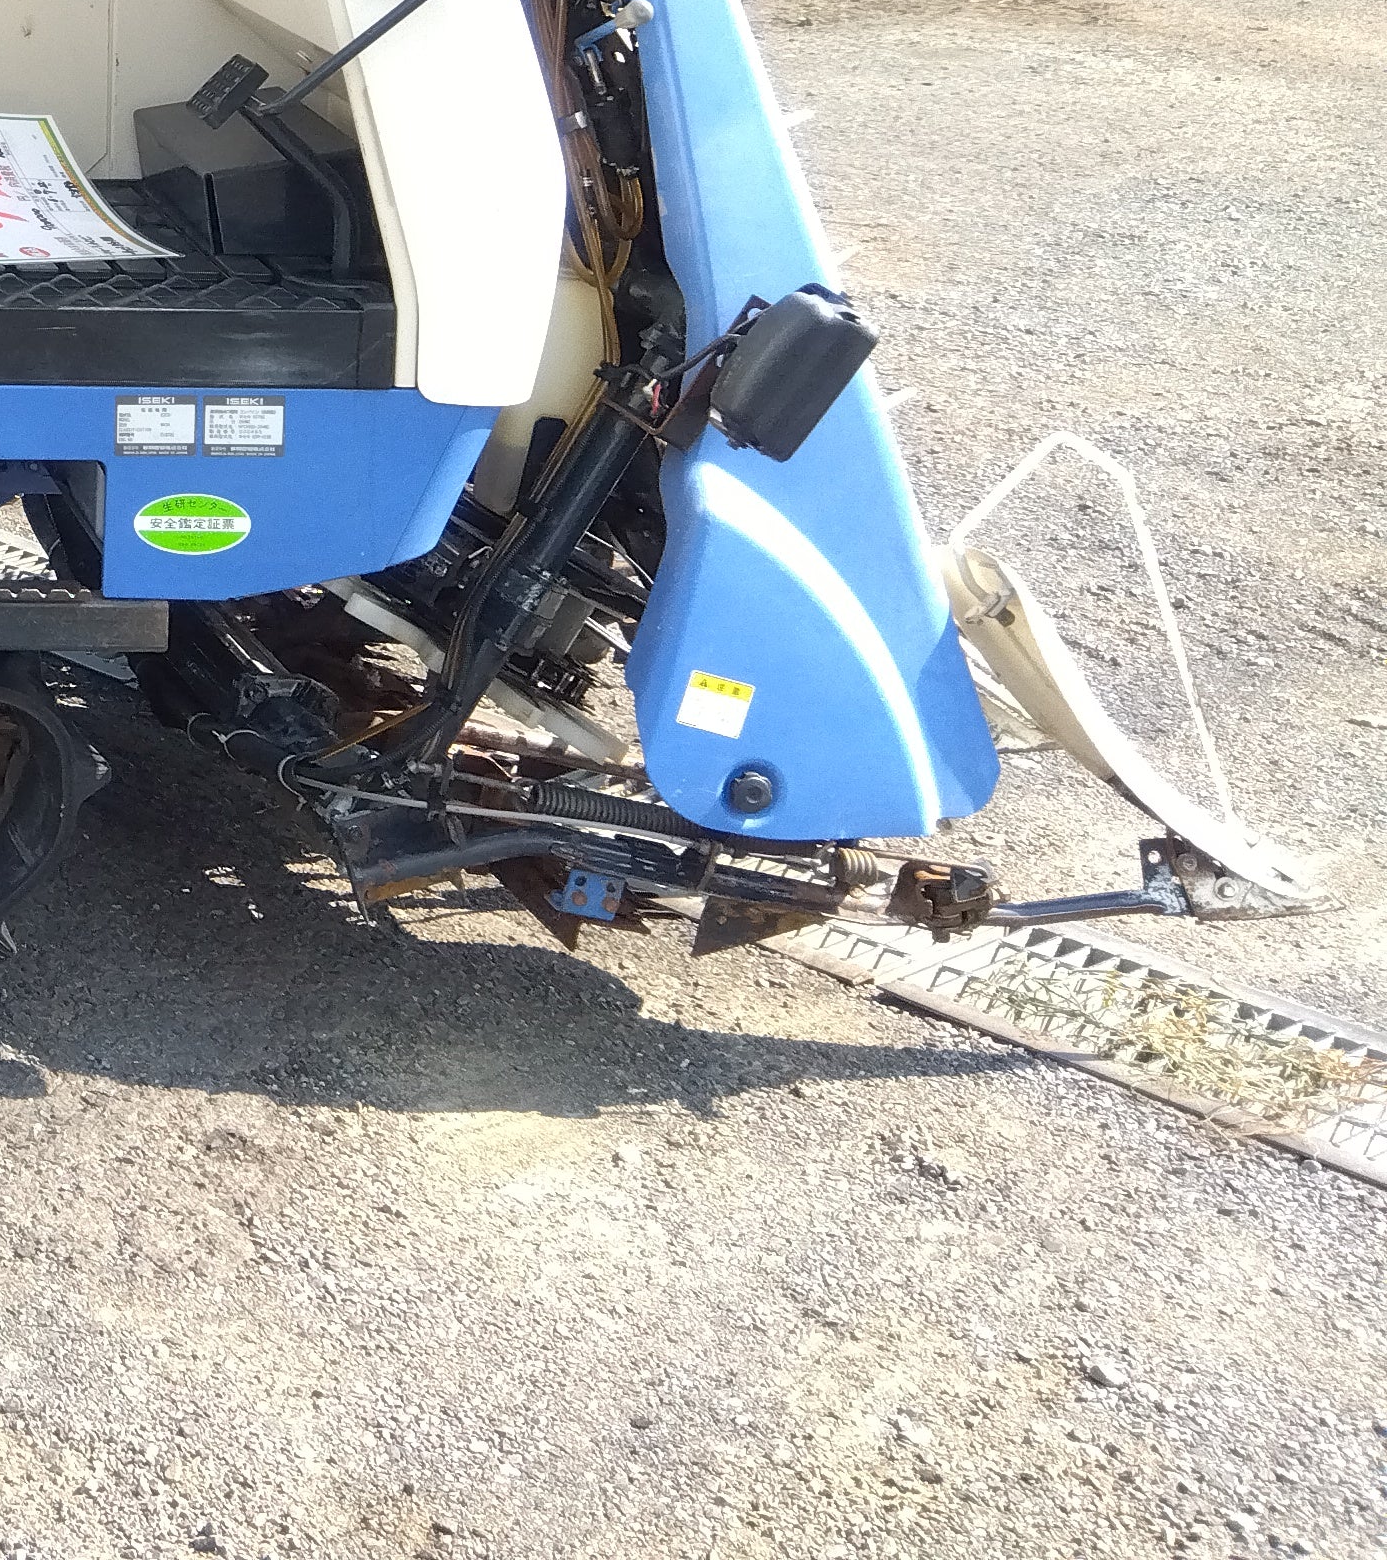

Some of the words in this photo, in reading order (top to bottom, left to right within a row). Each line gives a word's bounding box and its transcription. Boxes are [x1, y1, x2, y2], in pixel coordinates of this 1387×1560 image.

[226, 397, 264, 406] ISEKI
[163, 499, 227, 512] 生研センター
[150, 518, 235, 529] 安全鑑定証票
